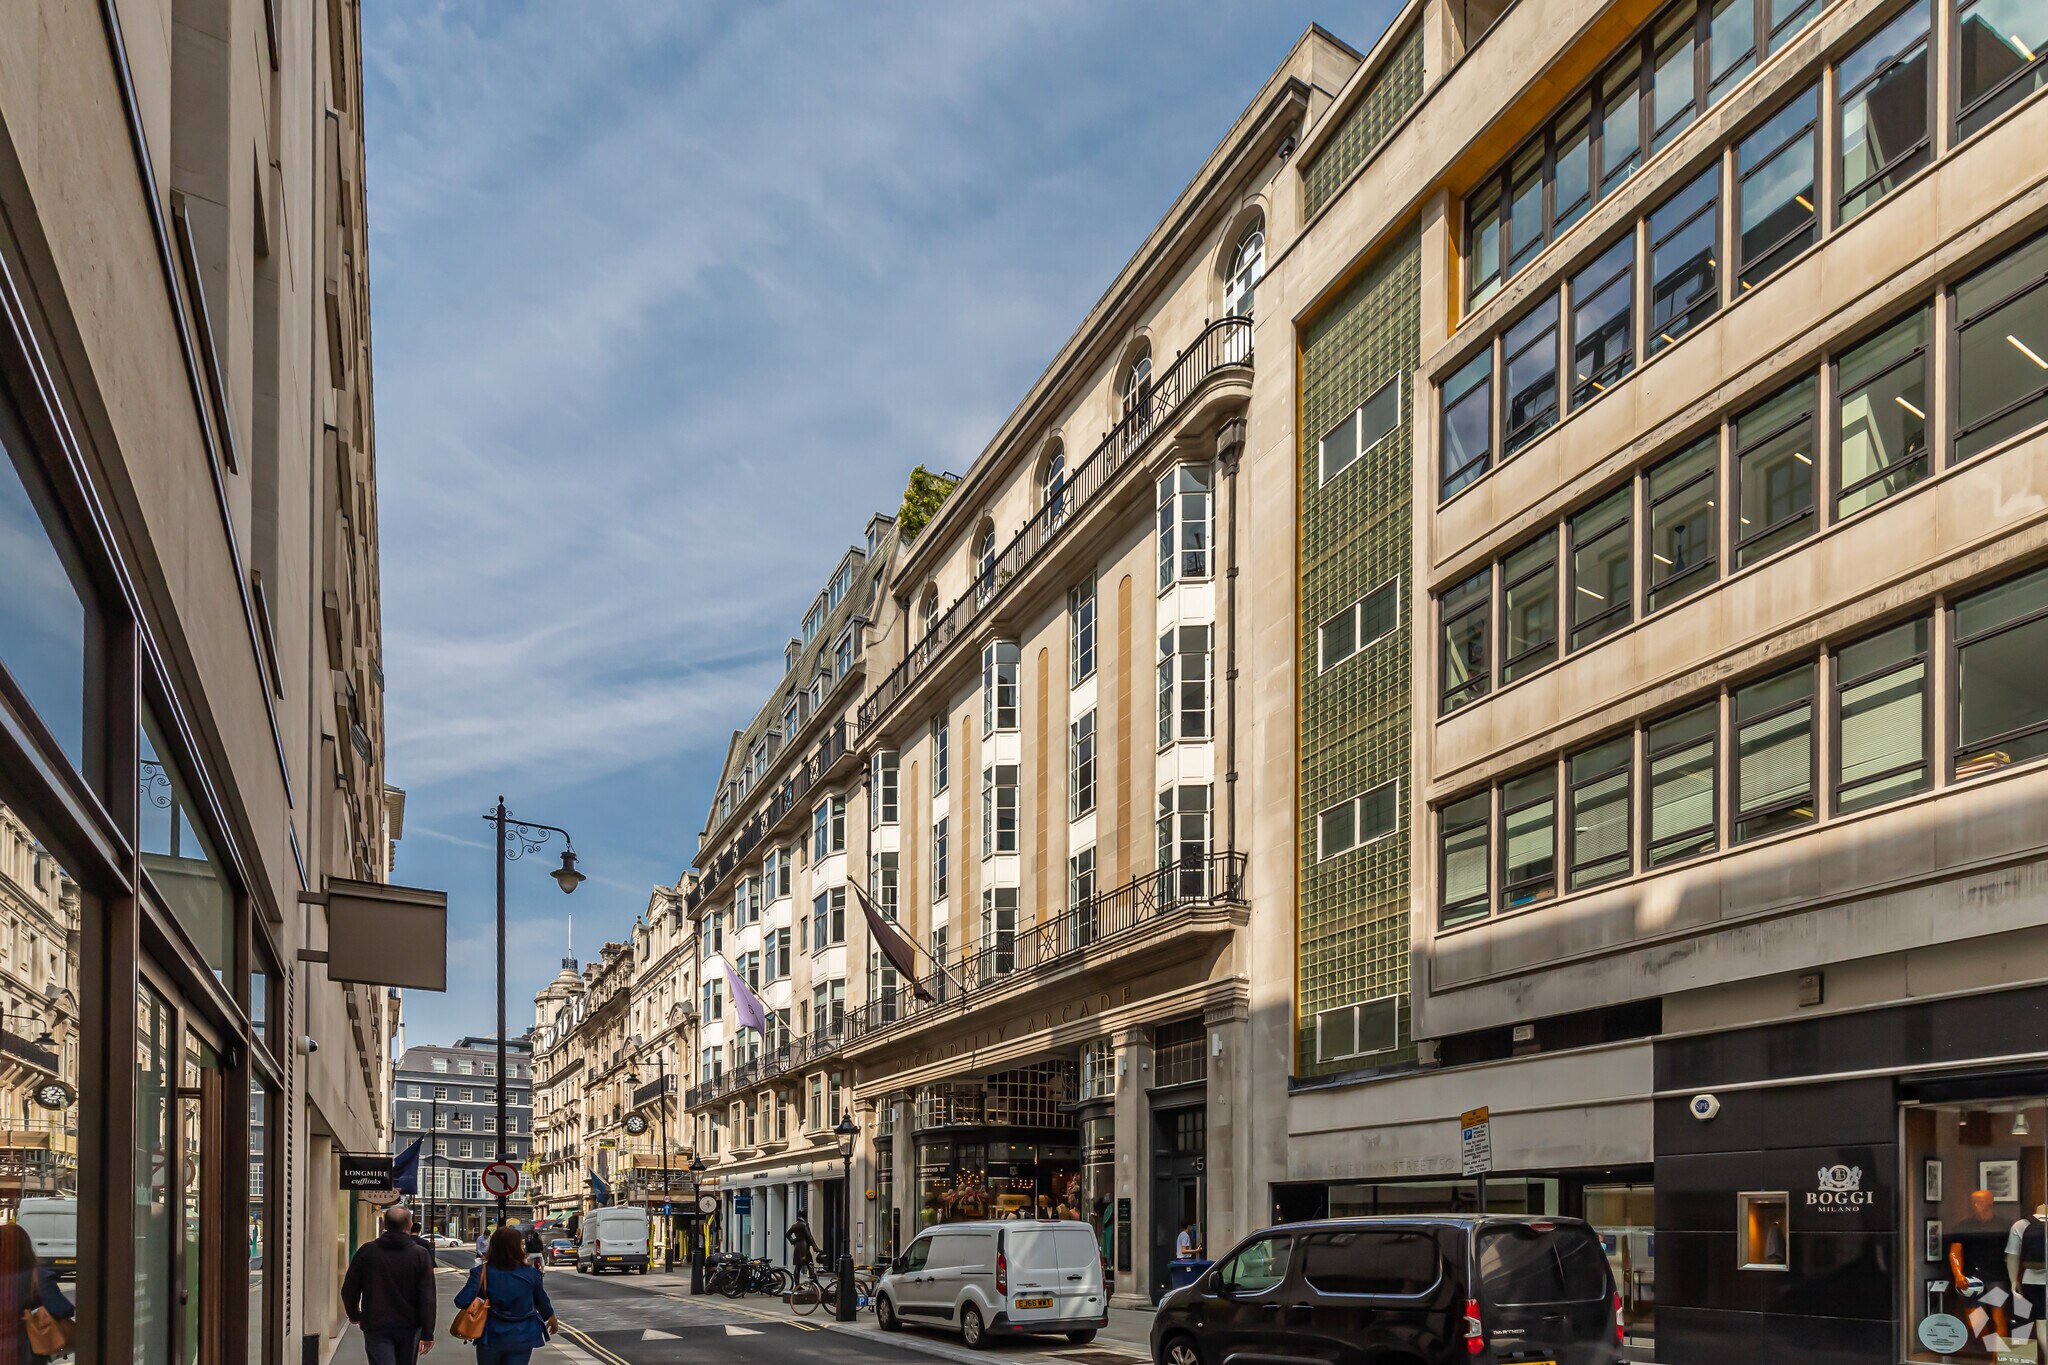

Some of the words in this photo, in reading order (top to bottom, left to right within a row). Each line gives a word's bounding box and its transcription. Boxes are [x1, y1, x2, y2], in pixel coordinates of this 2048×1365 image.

[1028, 986, 1130, 1034] ARCADE
[1393, 1159, 1432, 1173] STREET
[1806, 1191, 1874, 1204] BOGGI
